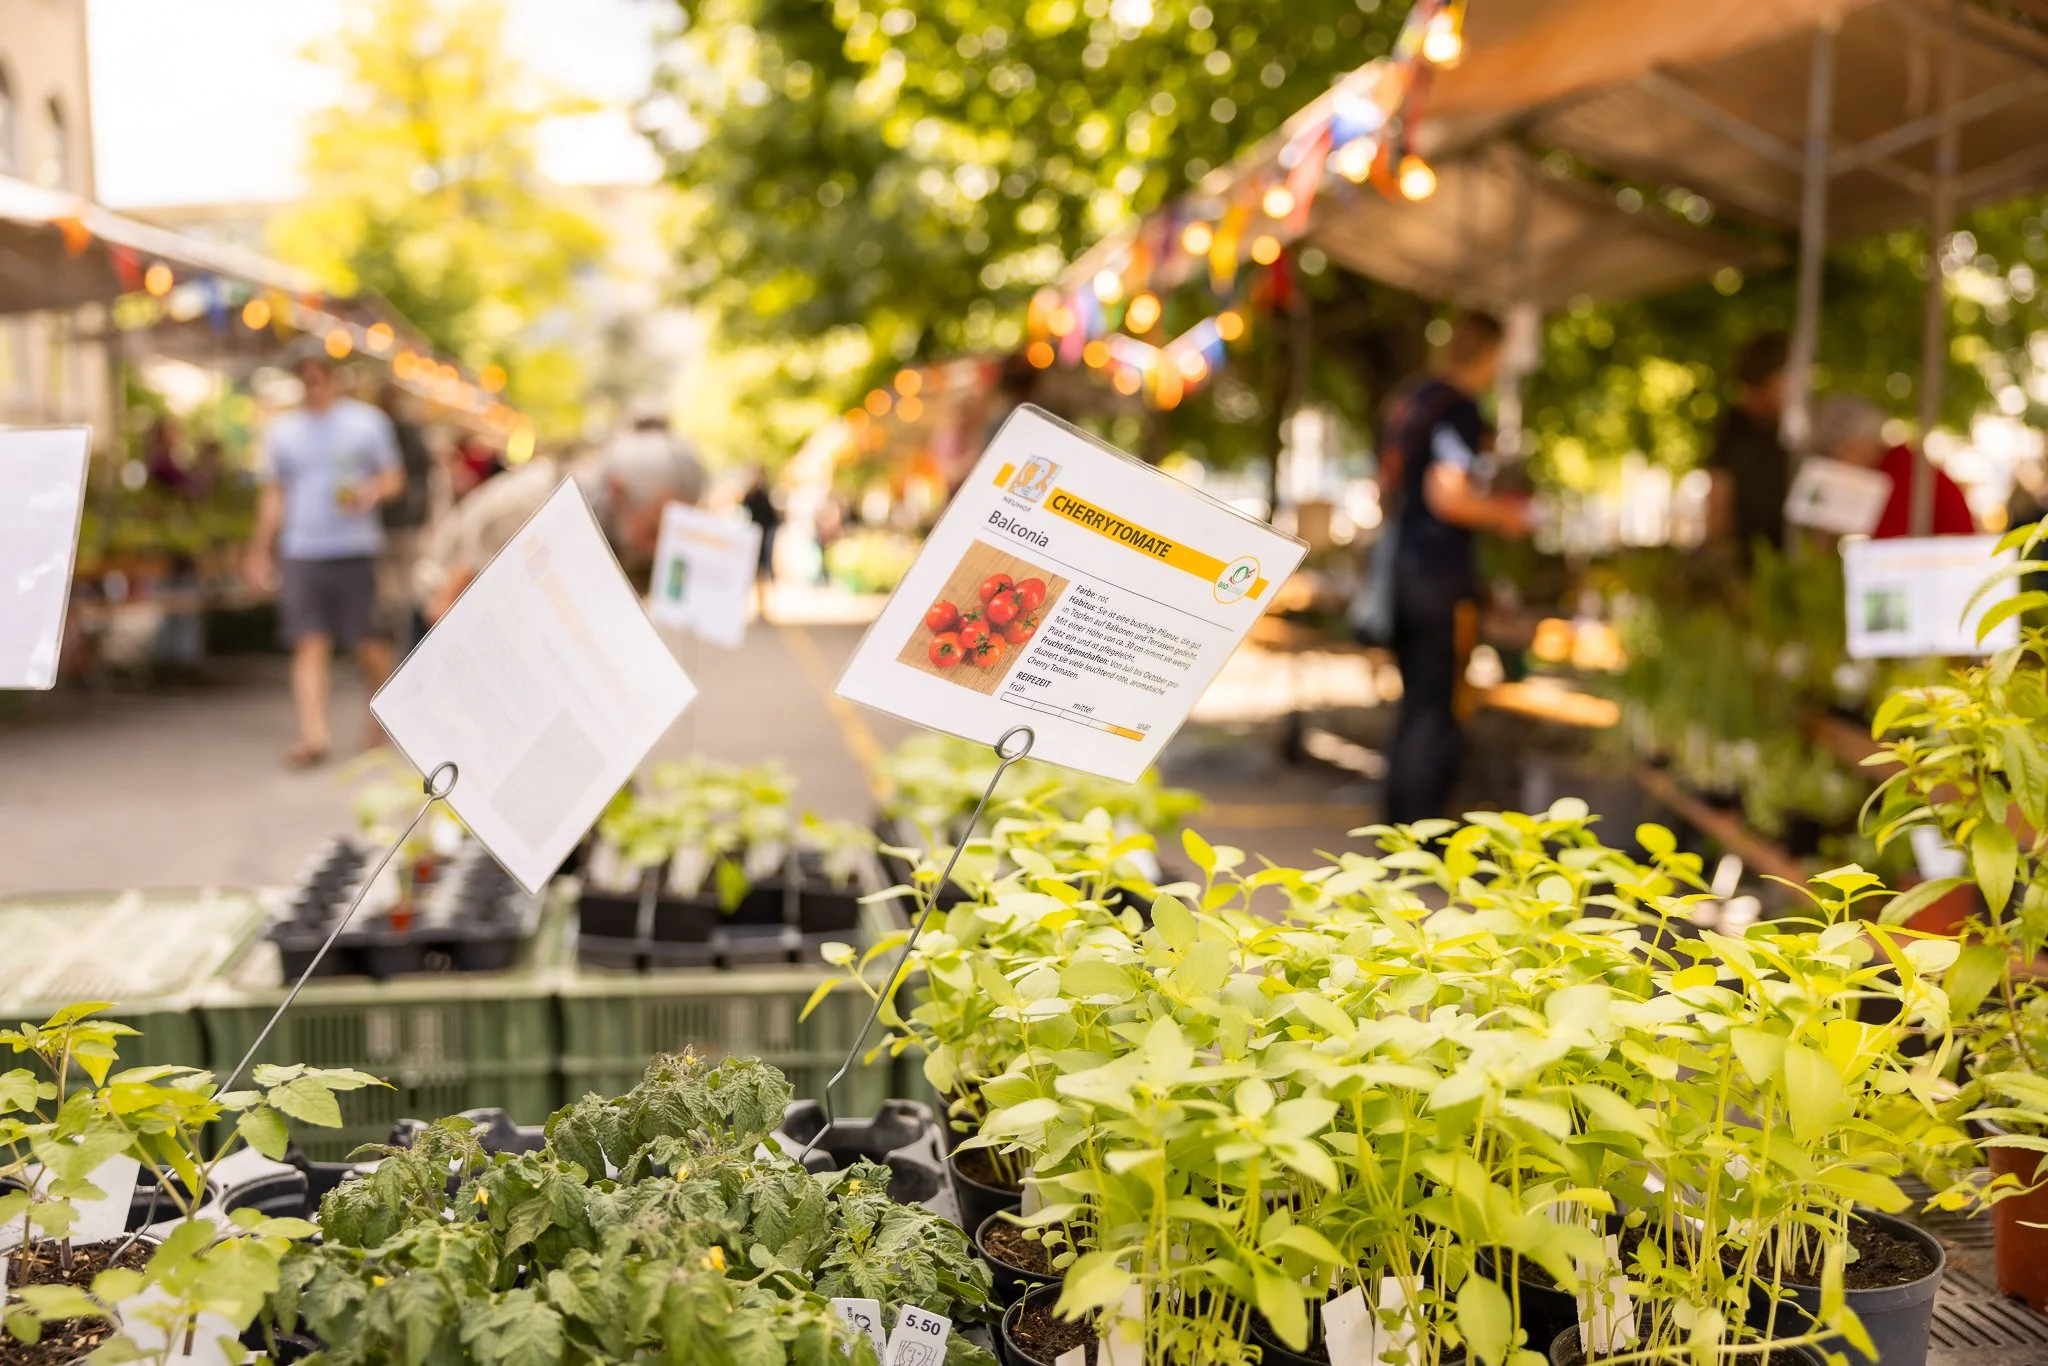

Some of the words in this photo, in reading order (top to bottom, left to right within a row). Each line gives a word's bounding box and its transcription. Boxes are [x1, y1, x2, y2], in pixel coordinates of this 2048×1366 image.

[1002, 495, 1032, 513] NEUHOF
[988, 509, 1050, 548] Balconia
[1051, 494, 1172, 558] CHERRYTOMATE
[1075, 584, 1098, 599] Farbe:
[1097, 594, 1109, 603] rot
[1061, 606, 1071, 614] in
[1092, 618, 1107, 627] auf
[1104, 621, 1135, 637] Balkonen
[1133, 633, 1149, 642] und
[1146, 637, 1175, 652] Terrassen
[1068, 595, 1099, 611] Habitus:
[1096, 606, 1108, 616] Sie
[1107, 610, 1117, 619] ist
[1115, 614, 1131, 624] eine
[1129, 618, 1158, 634] buschige
[1179, 638, 1191, 646] die
[1188, 641, 1202, 650] gut
[1039, 636, 1110, 666] Frucht/Eigenschaften:
[1109, 660, 1122, 668] Von
[1121, 664, 1134, 673] Juli
[1133, 668, 1144, 676] bis
[1142, 672, 1168, 684] Oktober
[1047, 626, 1066, 638] Platz
[1064, 633, 1078, 642] ein
[1076, 637, 1092, 647] und
[1089, 642, 1100, 650] ist
[1097, 645, 1136, 663] pflegeleicht.
[1054, 615, 1069, 626] Mit
[1067, 621, 1087, 632] einer
[1102, 634, 1117, 643] von
[1114, 638, 1125, 646] ca.
[1124, 641, 1135, 649] 30
[1132, 644, 1145, 653] cm
[1162, 655, 1173, 663] sie
[1171, 658, 1191, 670] wenig
[1015, 671, 1052, 688] REIFEZEIT
[1026, 656, 1050, 670] Cherry
[1033, 645, 1060, 660] duziert
[1057, 655, 1070, 663] sie
[1067, 658, 1085, 669] viele
[1083, 662, 1116, 679] leuchtend
[1128, 679, 1166, 695] aromatische
[1008, 681, 1026, 693] früh
[1071, 702, 1094, 714] mittel
[906, 1314, 941, 1336] 5.50
